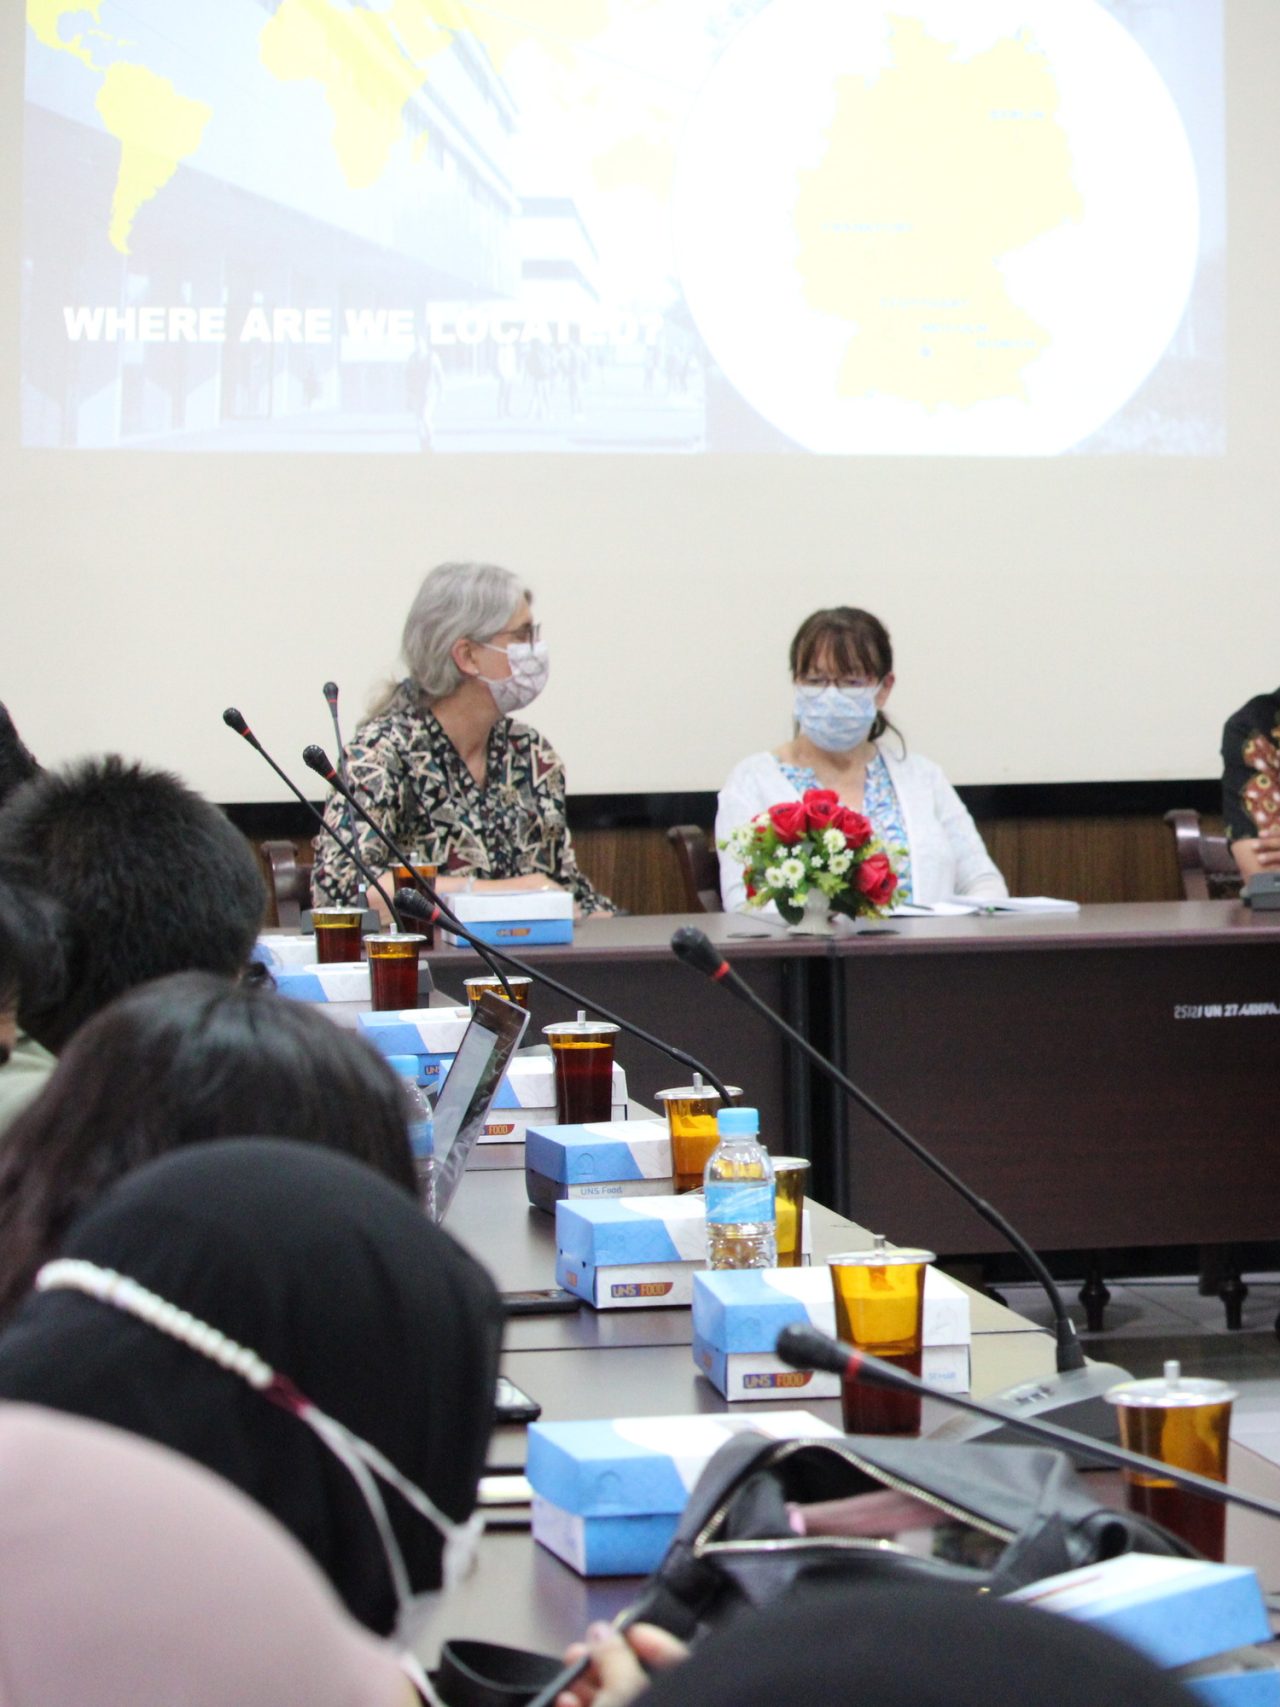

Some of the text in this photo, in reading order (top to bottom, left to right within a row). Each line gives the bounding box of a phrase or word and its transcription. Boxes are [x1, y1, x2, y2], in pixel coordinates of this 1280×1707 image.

[63, 306, 227, 342] WHERE
[239, 307, 331, 343] ARE
[344, 308, 415, 343] WE
[612, 1282, 665, 1297] UNS FOOD
[745, 1372, 804, 1388] UNS FOOD
